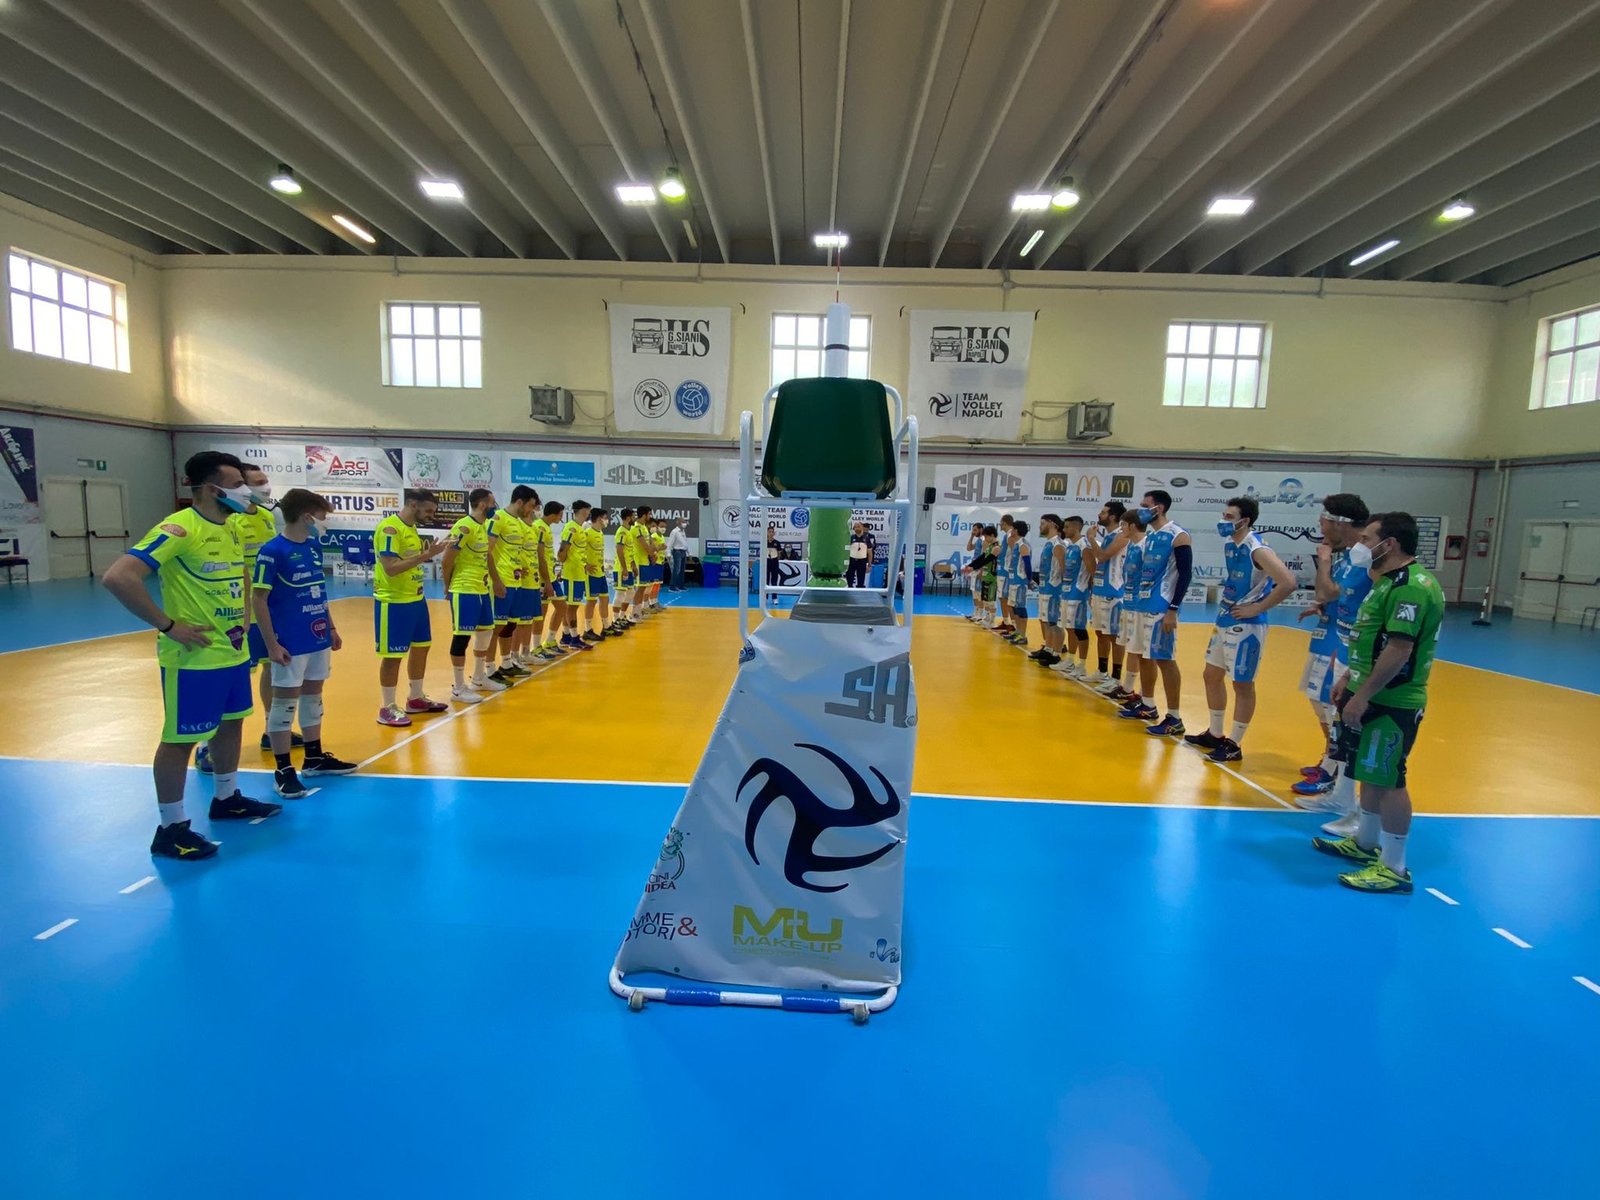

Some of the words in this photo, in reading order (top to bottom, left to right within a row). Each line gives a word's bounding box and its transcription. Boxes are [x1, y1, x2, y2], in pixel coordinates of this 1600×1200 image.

[962, 393, 989, 401] TEAM
[962, 401, 1003, 410] VOLLEY
[962, 409, 1003, 418] NAPOLI
[376, 496, 399, 508] LIFE
[677, 917, 698, 936] &
